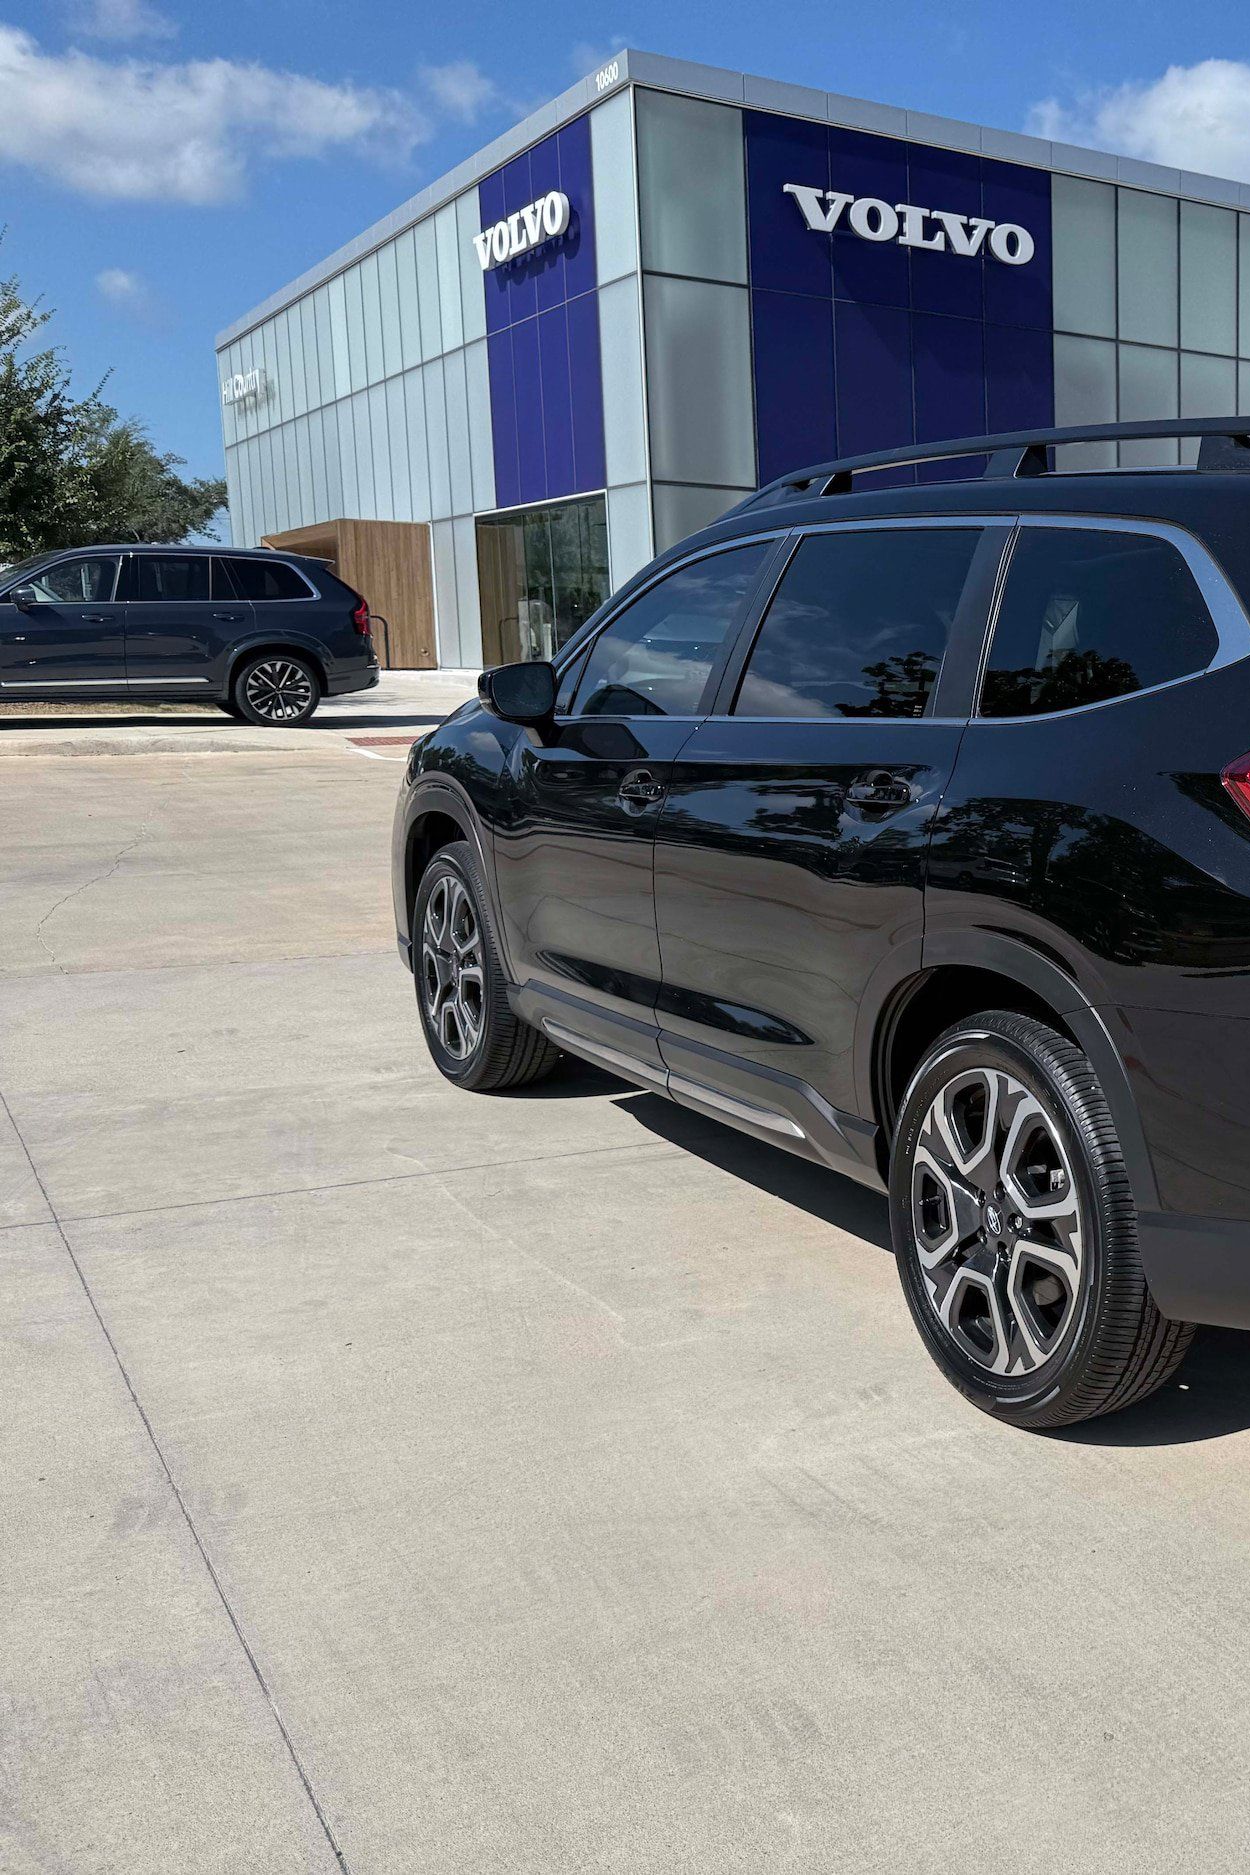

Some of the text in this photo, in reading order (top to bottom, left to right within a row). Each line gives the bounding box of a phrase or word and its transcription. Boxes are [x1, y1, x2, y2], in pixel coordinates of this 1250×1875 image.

[595, 61, 619, 92] 10600
[472, 190, 570, 271] VOLVO
[782, 182, 1035, 266] VOLVO
